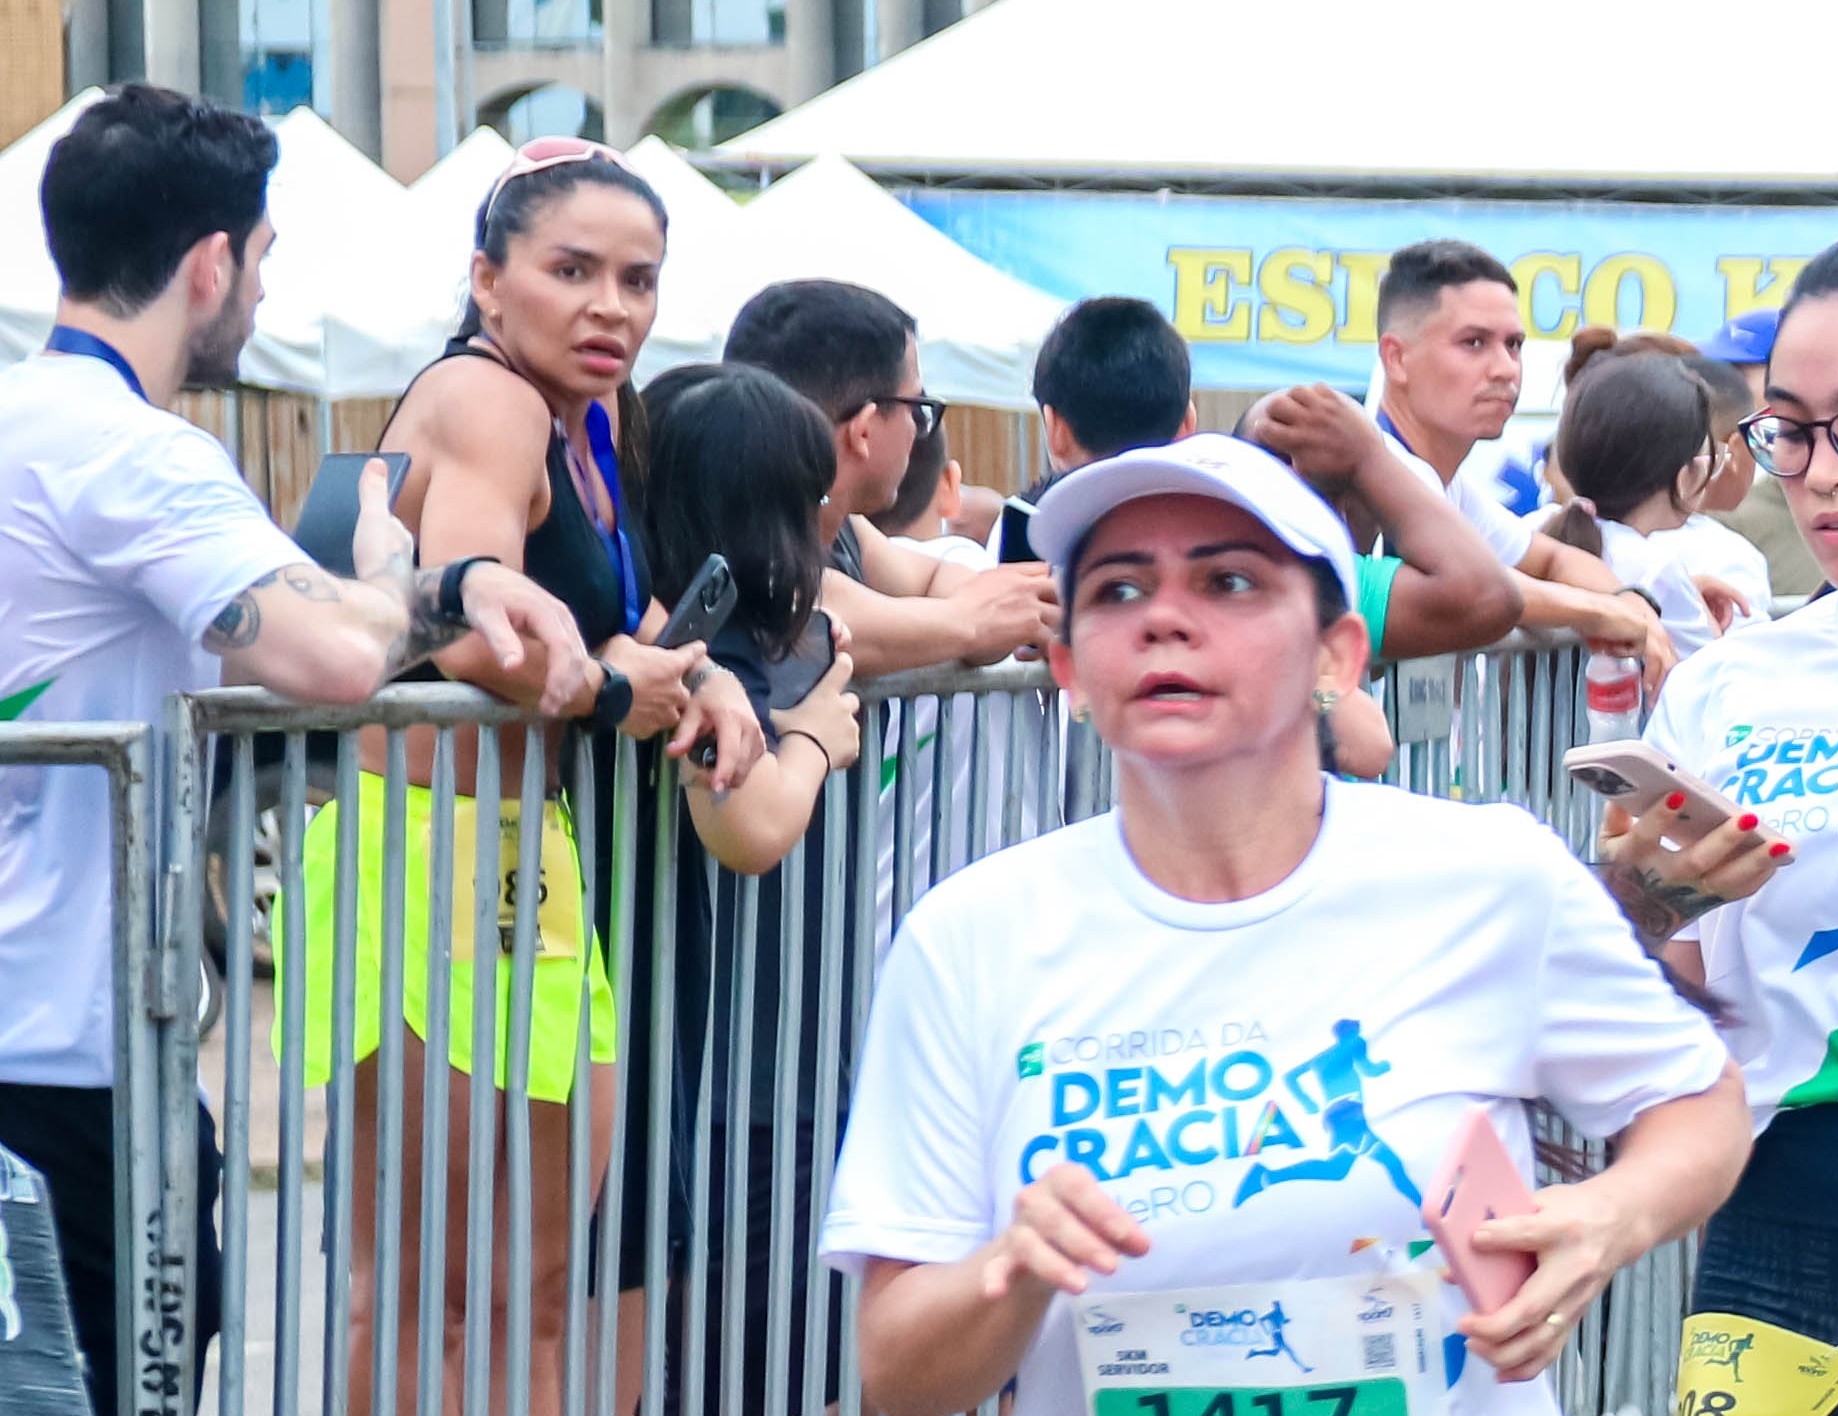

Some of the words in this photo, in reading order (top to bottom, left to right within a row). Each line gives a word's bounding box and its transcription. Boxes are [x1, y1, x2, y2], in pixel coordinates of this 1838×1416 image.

[1051, 1027, 1208, 1066] CORRIDA
[1221, 1021, 1268, 1047] DA
[1051, 1049, 1273, 1128] DEMO
[1018, 1099, 1306, 1186] CRACIA
[1190, 1308, 1256, 1328] DEMO
